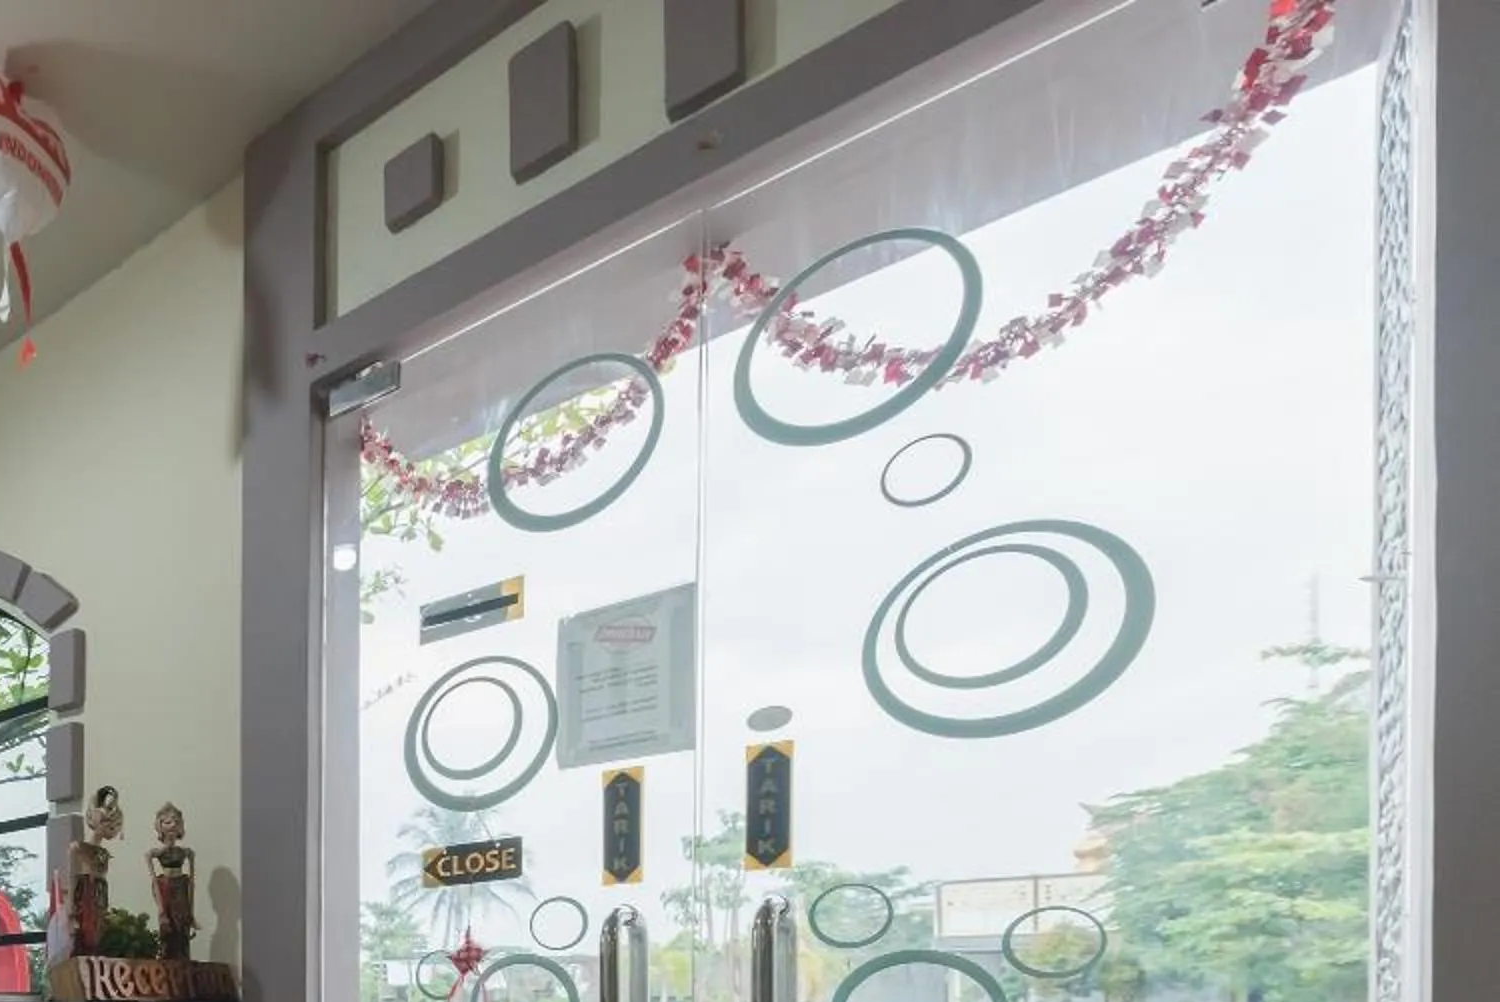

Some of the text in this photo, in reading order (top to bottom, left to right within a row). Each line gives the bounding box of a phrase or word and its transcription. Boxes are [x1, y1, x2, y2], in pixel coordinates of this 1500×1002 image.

[613, 779, 630, 871] TARIK
[755, 756, 778, 855] TARIK
[436, 847, 517, 877] CLOSE
